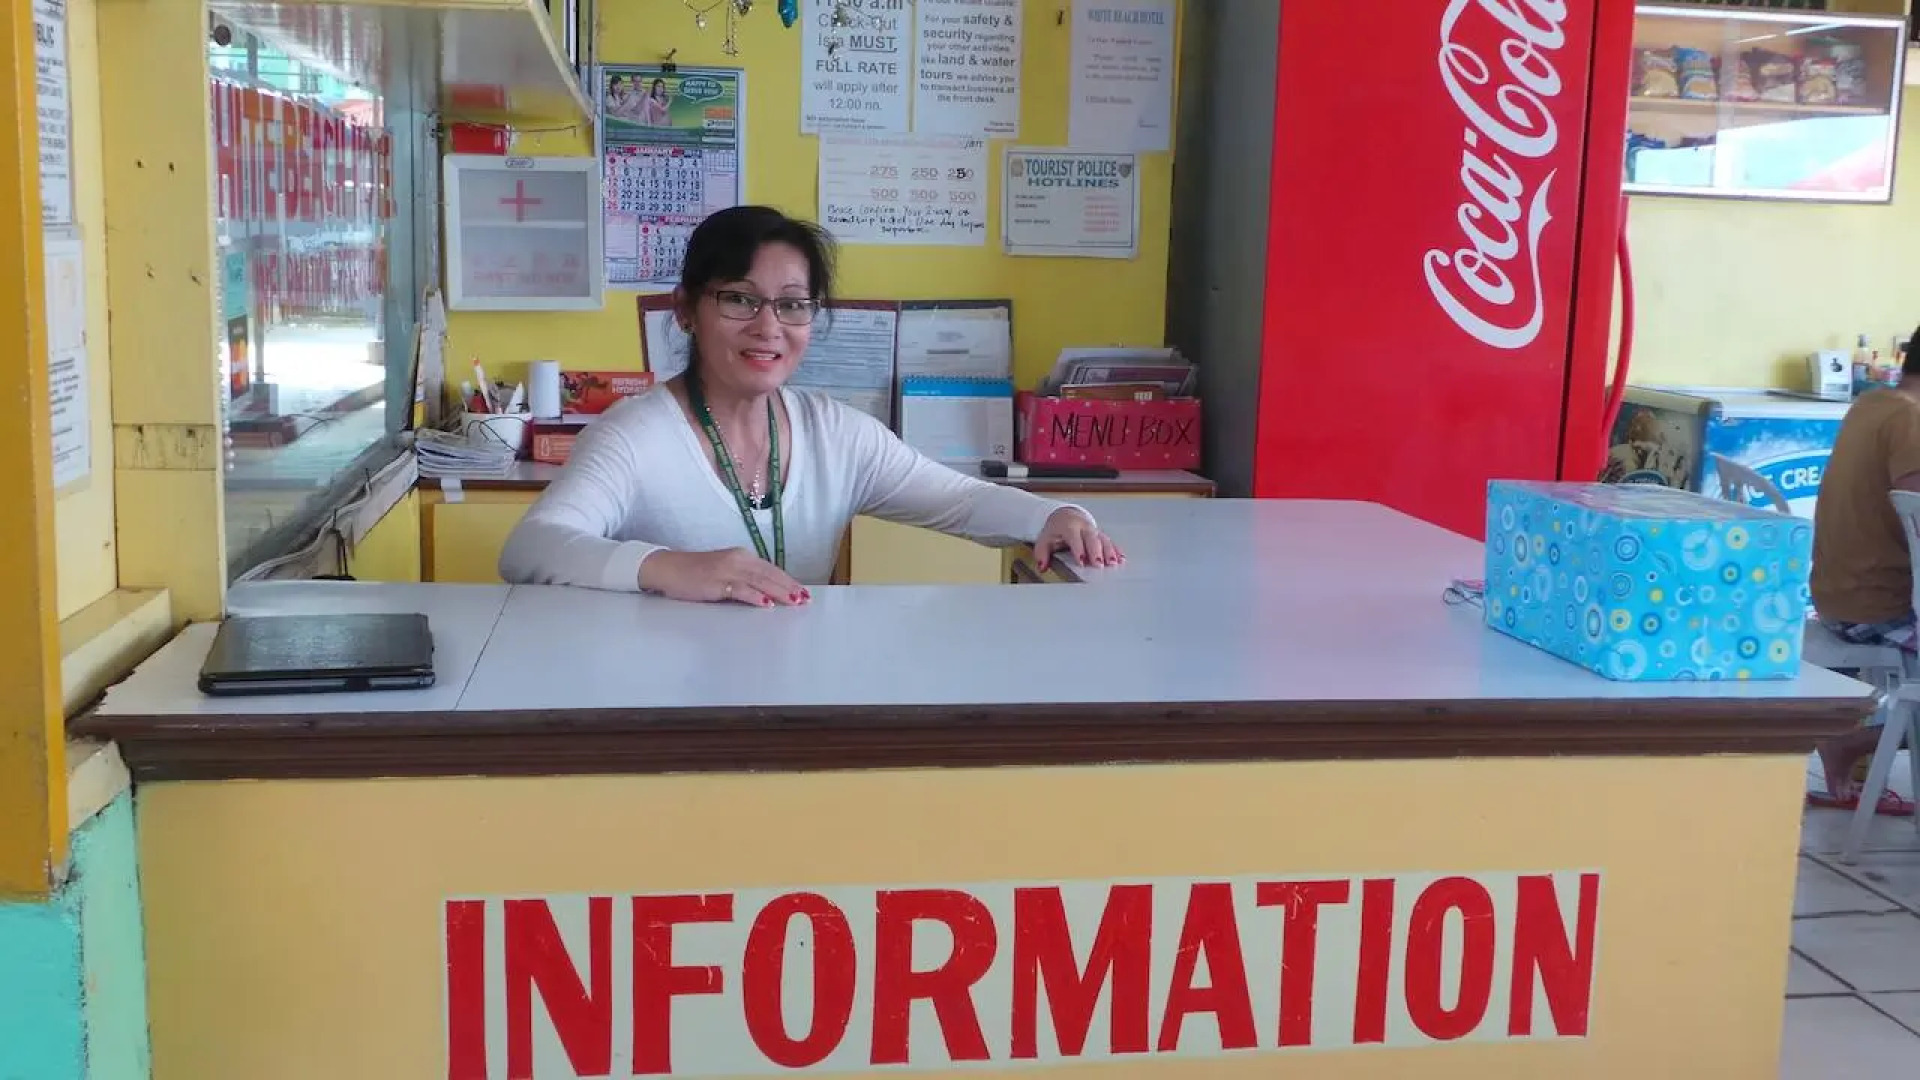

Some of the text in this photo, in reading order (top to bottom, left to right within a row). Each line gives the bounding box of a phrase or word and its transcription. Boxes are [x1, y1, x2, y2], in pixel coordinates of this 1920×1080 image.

[963, 14, 1000, 27] safety
[1004, 15, 1013, 25] &
[923, 28, 972, 42] security
[815, 59, 897, 75] FULL RATE
[938, 54, 965, 65] land
[969, 55, 978, 66] &
[981, 57, 1015, 67] water
[920, 69, 953, 80] tours
[814, 81, 898, 95] will apply after
[830, 98, 862, 110] 12:00
[911, 167, 938, 178] 250
[1024, 158, 1117, 177] TOURIST POLICE
[677, 170, 687, 179] 10
[690, 170, 700, 179] 11
[1424, 0, 1567, 349] Coca-Col
[621, 178, 632, 187] 13
[635, 179, 646, 188] 14
[649, 179, 659, 188] 15
[677, 180, 686, 189] 17
[1028, 177, 1120, 188] HOTLINES
[621, 189, 632, 199] 20
[635, 190, 644, 199] 21
[649, 190, 659, 199] 22
[662, 191, 673, 200] 23
[676, 191, 686, 200] 24
[621, 201, 631, 210] 27
[635, 202, 646, 211] 28
[649, 202, 659, 211] 29
[662, 203, 673, 212] 30
[676, 203, 685, 212] 31
[654, 247, 665, 256] 10
[1050, 411, 1196, 448] MENU BOX
[1782, 465, 1822, 490] CRE
[446, 873, 1600, 1080] INFORMATION
